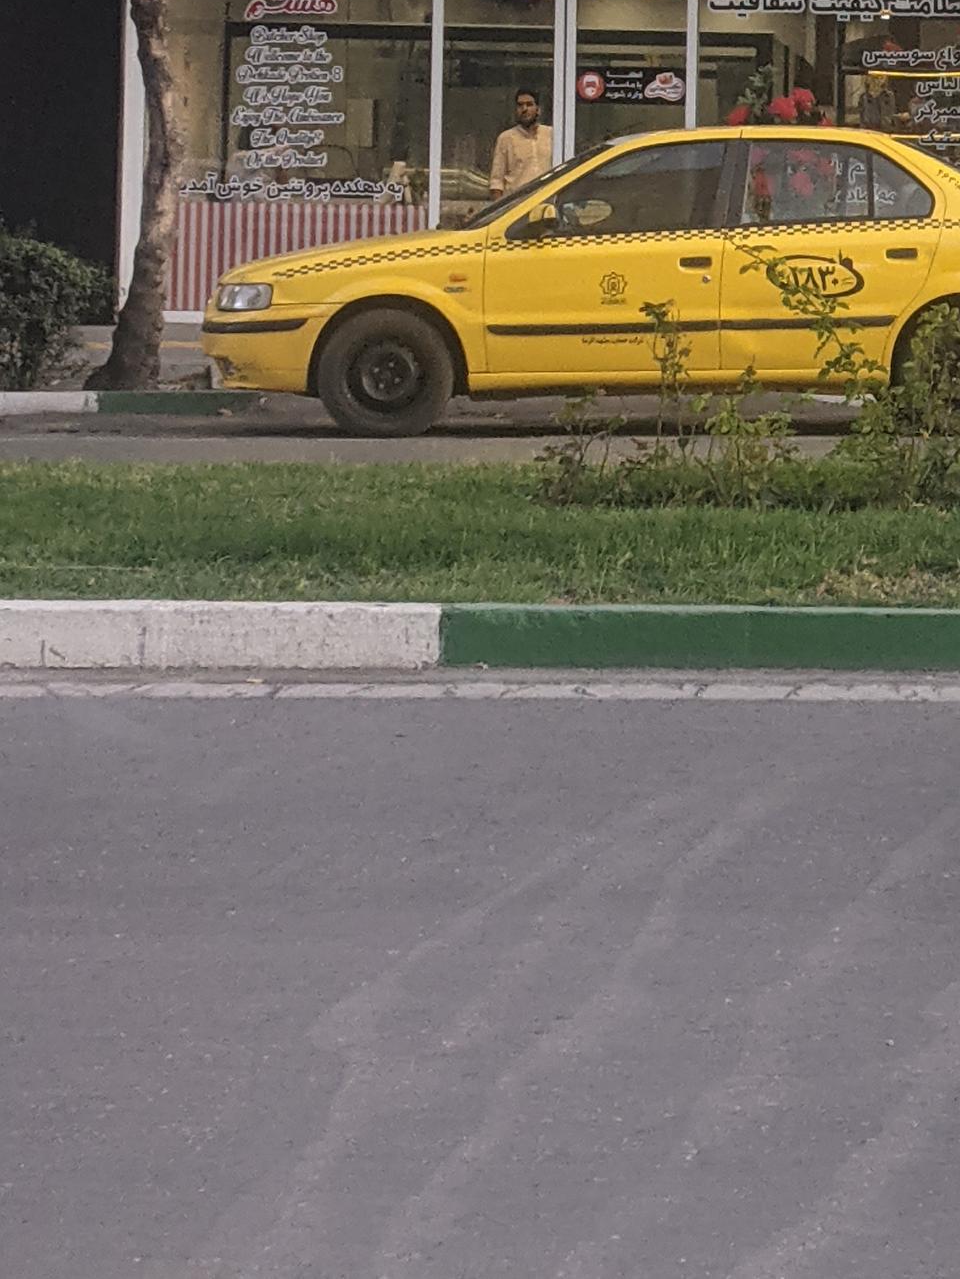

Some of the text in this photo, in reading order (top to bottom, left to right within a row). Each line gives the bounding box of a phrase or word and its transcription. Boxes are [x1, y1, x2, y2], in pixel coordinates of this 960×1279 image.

[861, 48, 935, 67] سوسیس
[331, 65, 343, 83] 8
[216, 175, 264, 199] خوش
[386, 182, 405, 202] به
